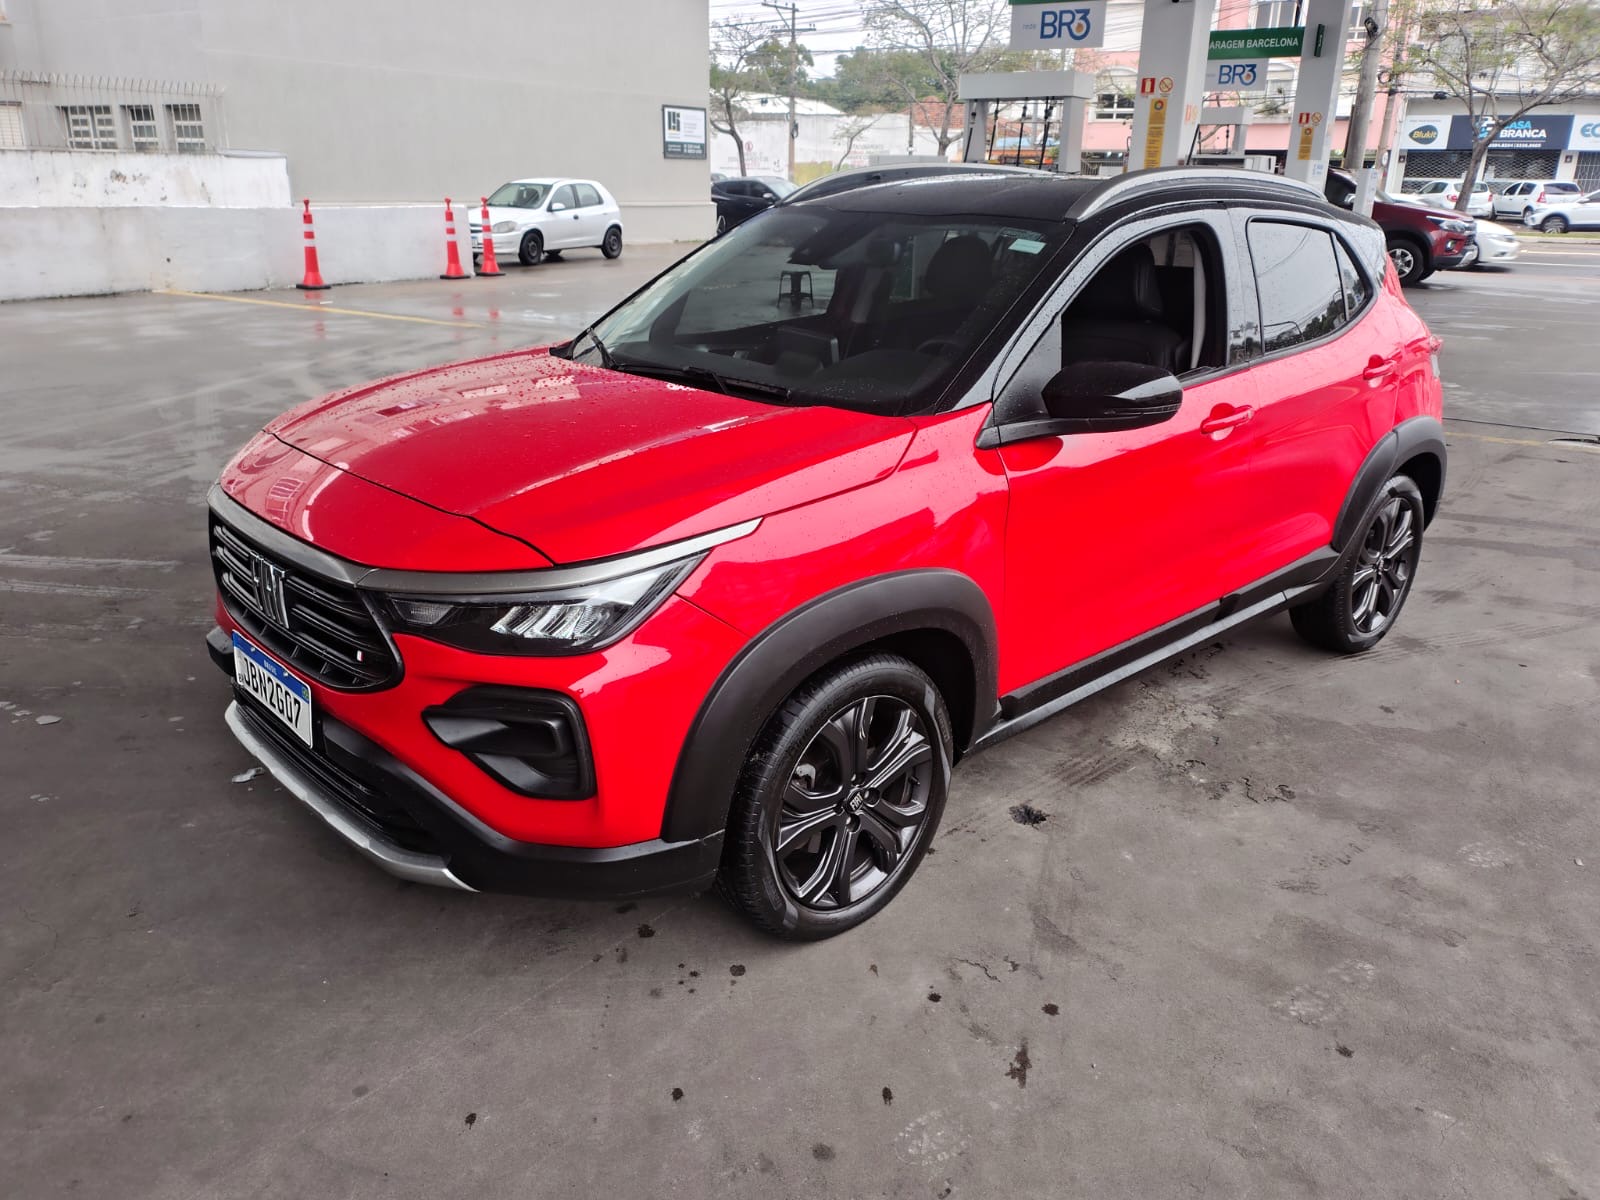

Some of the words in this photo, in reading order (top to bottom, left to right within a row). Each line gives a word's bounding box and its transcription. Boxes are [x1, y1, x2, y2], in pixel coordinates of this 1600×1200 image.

[1040, 8, 1090, 40] BR3
[1246, 37, 1299, 48] BARCELONA
[1218, 64, 1257, 86] BR3
[1499, 129, 1547, 138] BRANCA
[244, 657, 301, 729] JBN2G07
